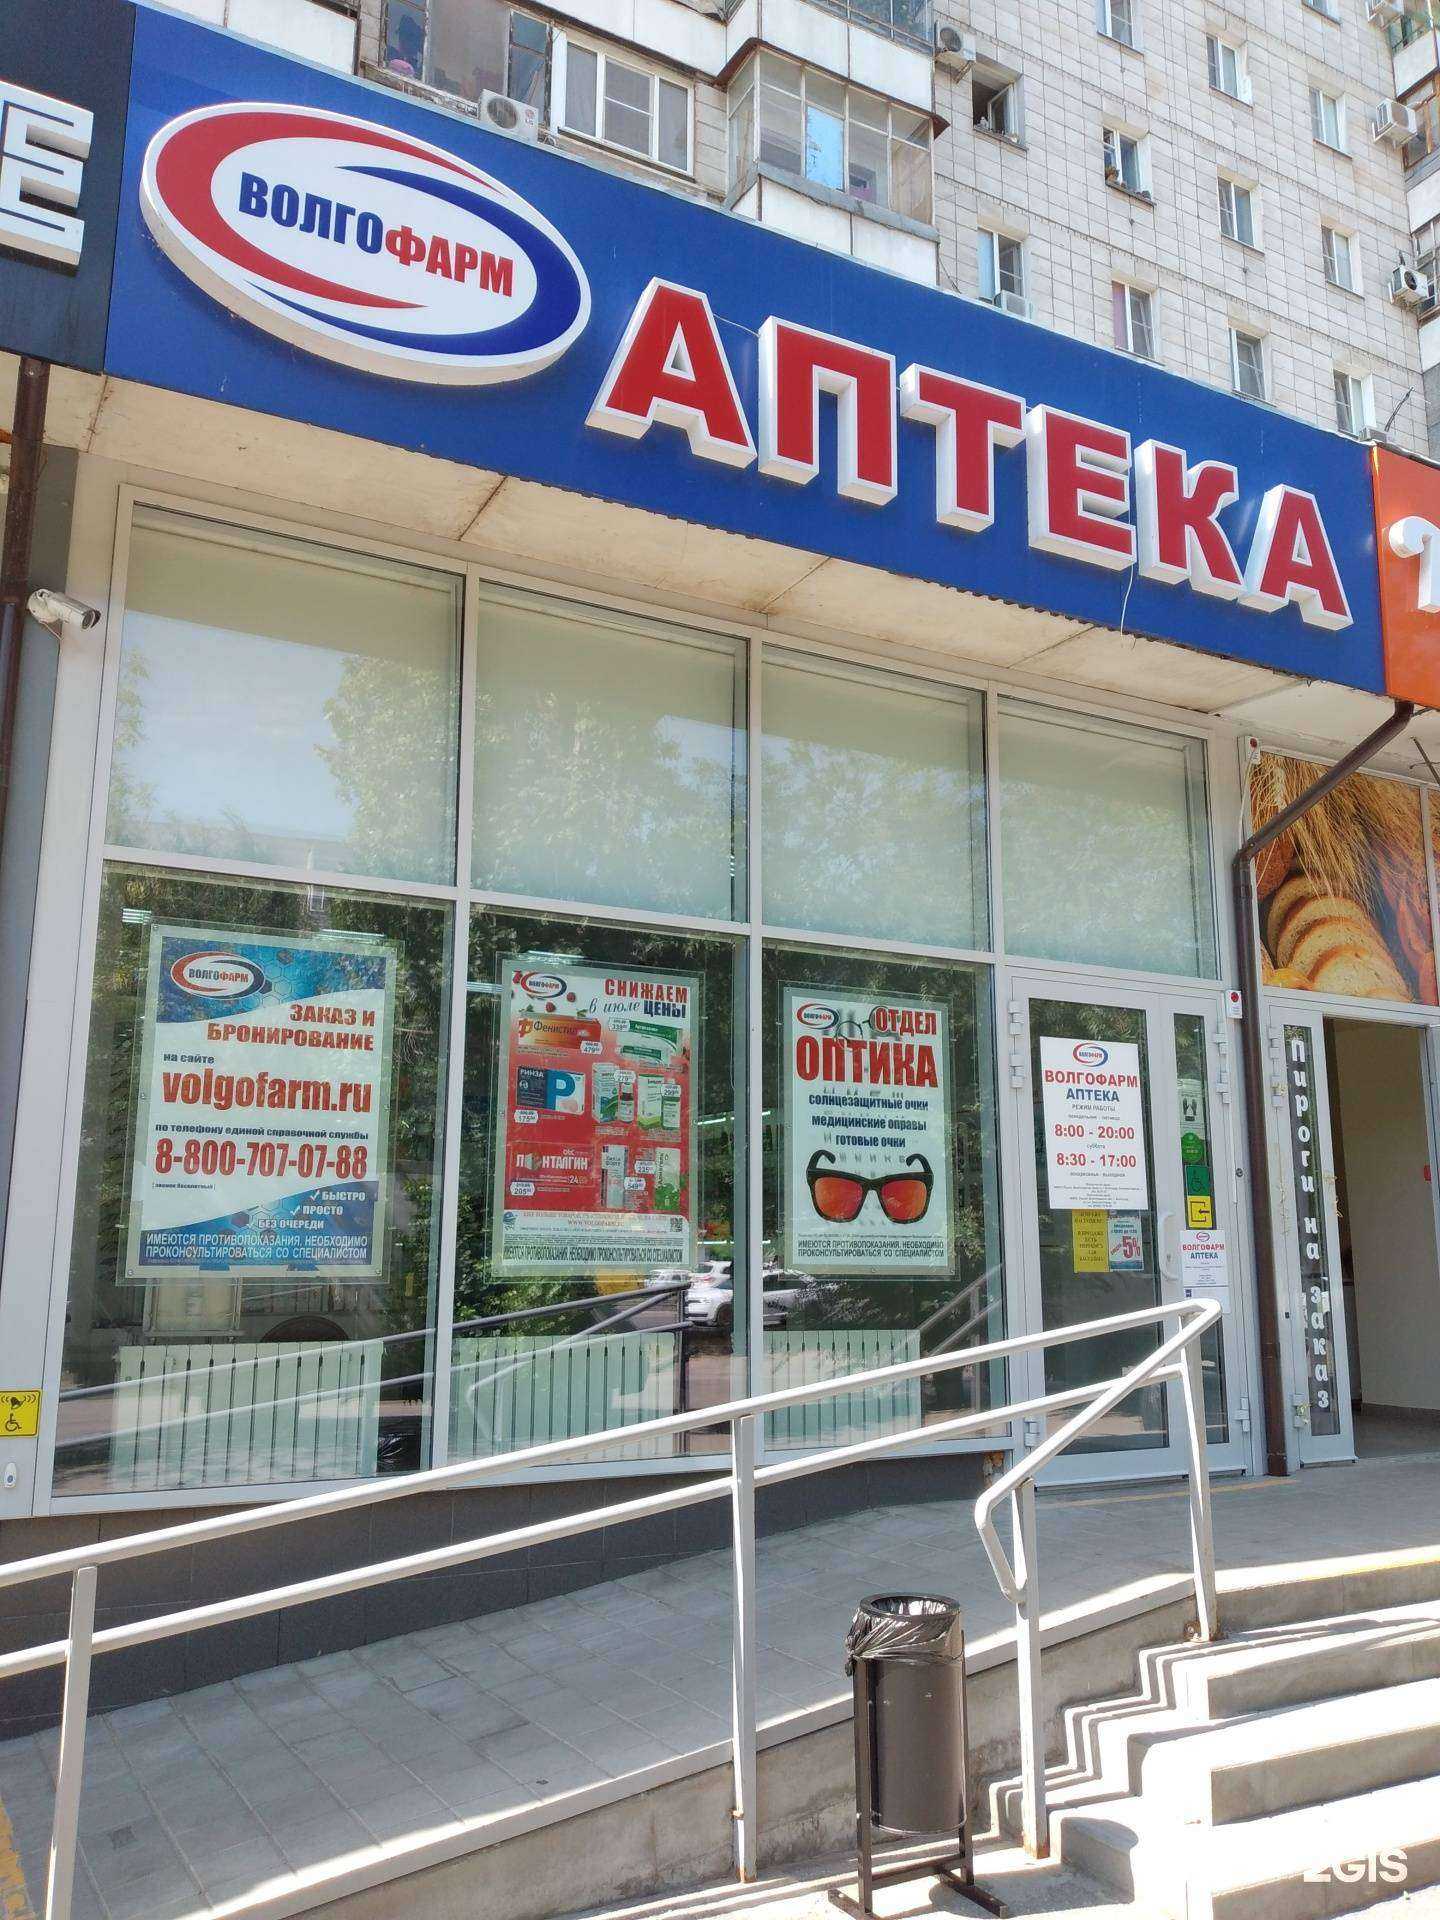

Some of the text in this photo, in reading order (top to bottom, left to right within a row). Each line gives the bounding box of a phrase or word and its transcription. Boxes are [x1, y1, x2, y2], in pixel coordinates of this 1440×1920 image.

[239, 172, 515, 298] ВОЛГОФАРМ
[585, 276, 1353, 631] АПТЕКА
[189, 968, 249, 983] ВОЛГОФАРМ
[604, 978, 688, 1004] СНИЖАЕМ
[290, 1004, 375, 1027] ЗАКАЗ И
[589, 998, 686, 1019] в июле ЦЕНЫ
[875, 1007, 937, 1036] ОТДЕЛ
[207, 1022, 374, 1051] БРОНИРОВАНИЕ
[163, 1053, 215, 1064] на сайте
[796, 1036, 938, 1088] ОПТИКА
[520, 1069, 545, 1078] РИНЗА
[1045, 1069, 1138, 1088] ВОЛГОФАРМ
[162, 1068, 373, 1113] volgofarm.ru
[1066, 1088, 1120, 1102] АПТЕКА
[809, 1094, 929, 1111] солнцезащитные очки
[812, 1115, 927, 1131] медицинские оправы
[155, 1124, 368, 1140] по телефону единой справочной службы
[1054, 1124, 1085, 1138] 8:00
[1098, 1126, 1135, 1140] 20:00
[836, 1134, 906, 1148] готовые очки
[155, 1138, 368, 1179] 8-800-707-07-88
[516, 1153, 588, 1170] ПНТАЛГИН
[1056, 1152, 1086, 1166] 8:30
[1100, 1154, 1137, 1168] 17:00
[321, 1191, 366, 1201] БЫСТРО
[302, 1205, 344, 1216] ПРОСТО
[258, 1219, 324, 1230] БЕЗ ОЧЕРЕДИ
[1290, 1038, 1329, 1408] Пироги на заказ
[146, 1234, 196, 1246] ИМЕЮТСЯ
[305, 1235, 368, 1248] НЕОБХОДИМО
[798, 1240, 831, 1248] ИМЕЮТСЯ
[903, 1241, 944, 1249] НЕОБХОДИМО
[146, 1247, 367, 1260] ПРОКОНСУЛЬТИРОВАТЬСЯ СО СПЕЦИАЛИСТОМ
[798, 1249, 945, 1258] ПРОКОНСУЛЬТИРОВАТЬСЯ СО СПЕЦИАЛИСТОМ
